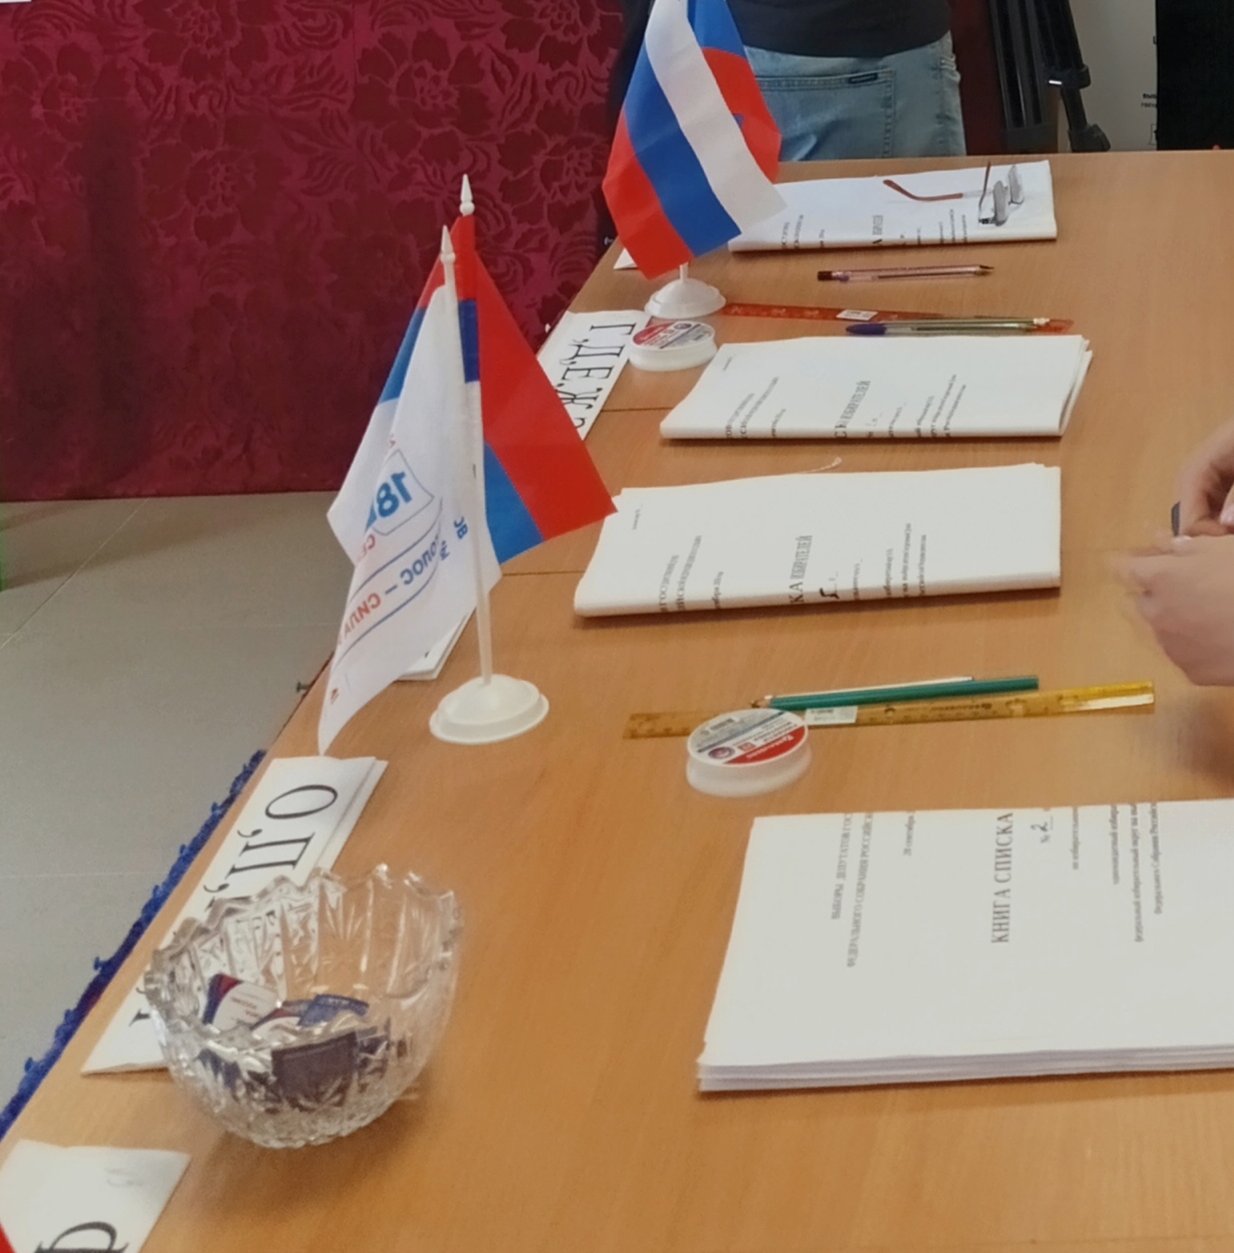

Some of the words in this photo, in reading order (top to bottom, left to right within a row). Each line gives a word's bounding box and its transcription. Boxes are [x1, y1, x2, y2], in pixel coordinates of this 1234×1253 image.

[836, 832, 850, 880] ДЕПУТАТОВ
[994, 812, 1013, 883] СПИСКА
[831, 884, 844, 919] ВЫБОРЫ
[846, 904, 863, 968] ФЕДЕРАЛЬНОГО
[855, 859, 869, 903] СОБРАНИЯ
[991, 888, 1011, 943] КНИГА
